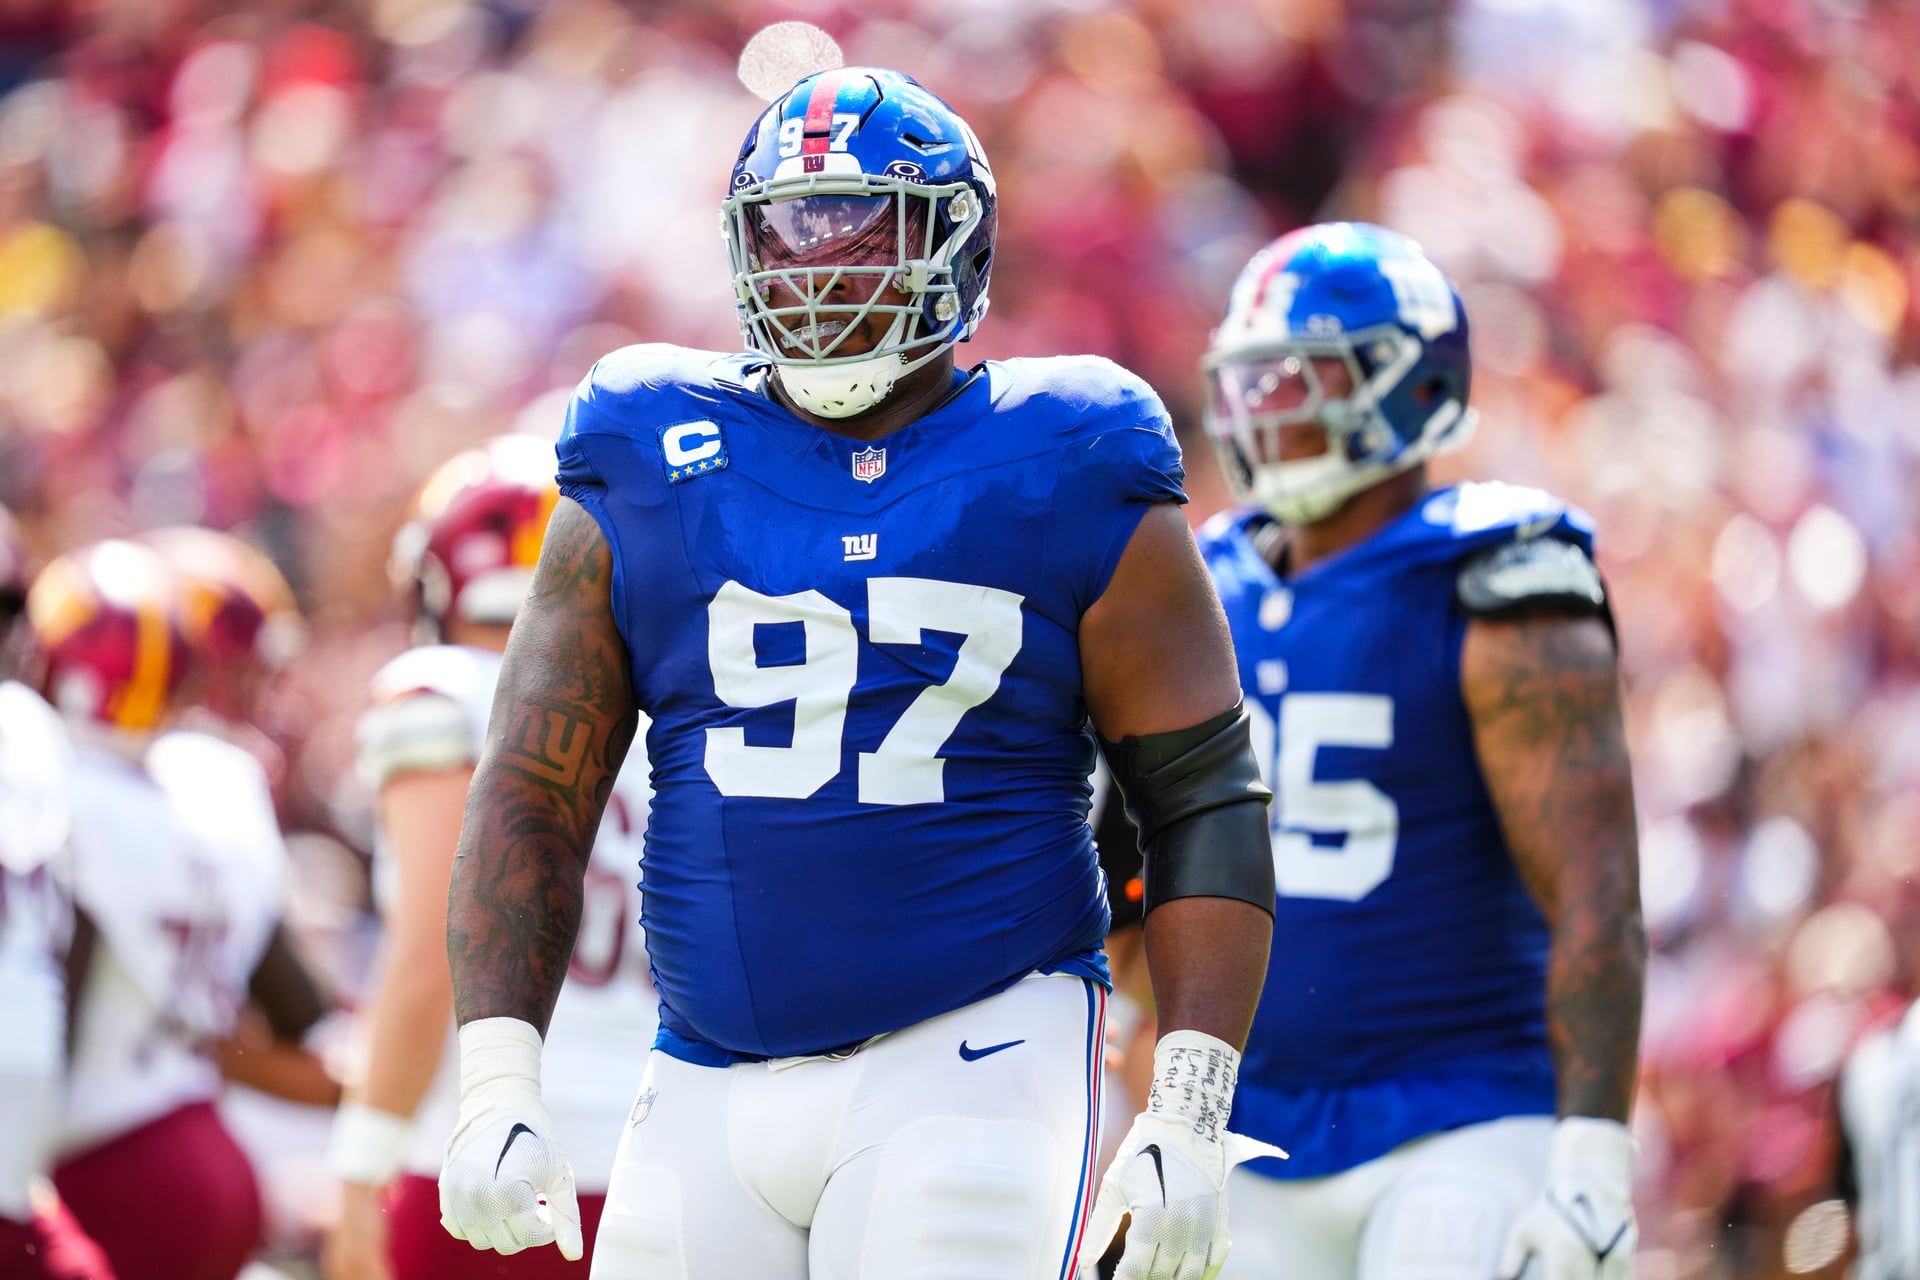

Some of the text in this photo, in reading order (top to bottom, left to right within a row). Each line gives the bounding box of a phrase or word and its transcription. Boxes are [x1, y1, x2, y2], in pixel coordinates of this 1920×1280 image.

[779, 113, 860, 157] 97
[663, 420, 721, 467] C
[858, 461, 882, 476] NFL
[703, 577, 1026, 806] 97
